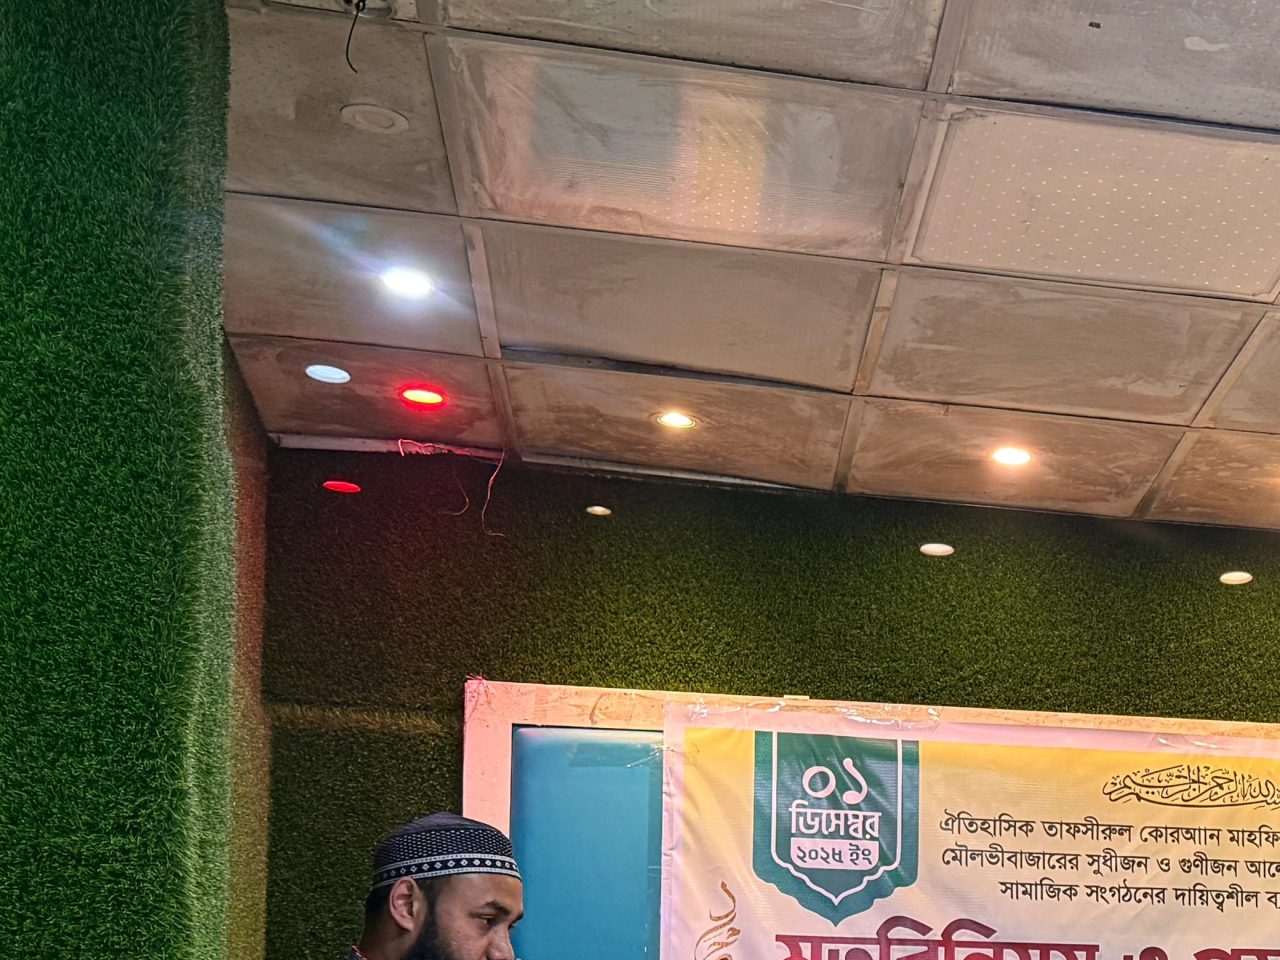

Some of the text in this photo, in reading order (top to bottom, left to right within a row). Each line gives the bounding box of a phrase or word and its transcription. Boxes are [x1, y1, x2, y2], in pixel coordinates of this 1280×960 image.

[802, 757, 868, 805] ০১
[789, 799, 882, 839] ডিসেম্বর
[940, 809, 1036, 838] ঐতিহাসিক
[1041, 816, 1134, 842] তাফসীরুল
[848, 842, 873, 866] ইং
[942, 842, 1082, 871] মৌলভীবাজারের
[1086, 847, 1151, 877] সুধীজন
[1156, 858, 1171, 873] ও
[1178, 851, 1239, 878] গুণীজন
[998, 877, 1079, 901] সামাজিক
[1084, 878, 1168, 905] সংগঠনের
[1172, 882, 1260, 913] দায়িত্বশীল
